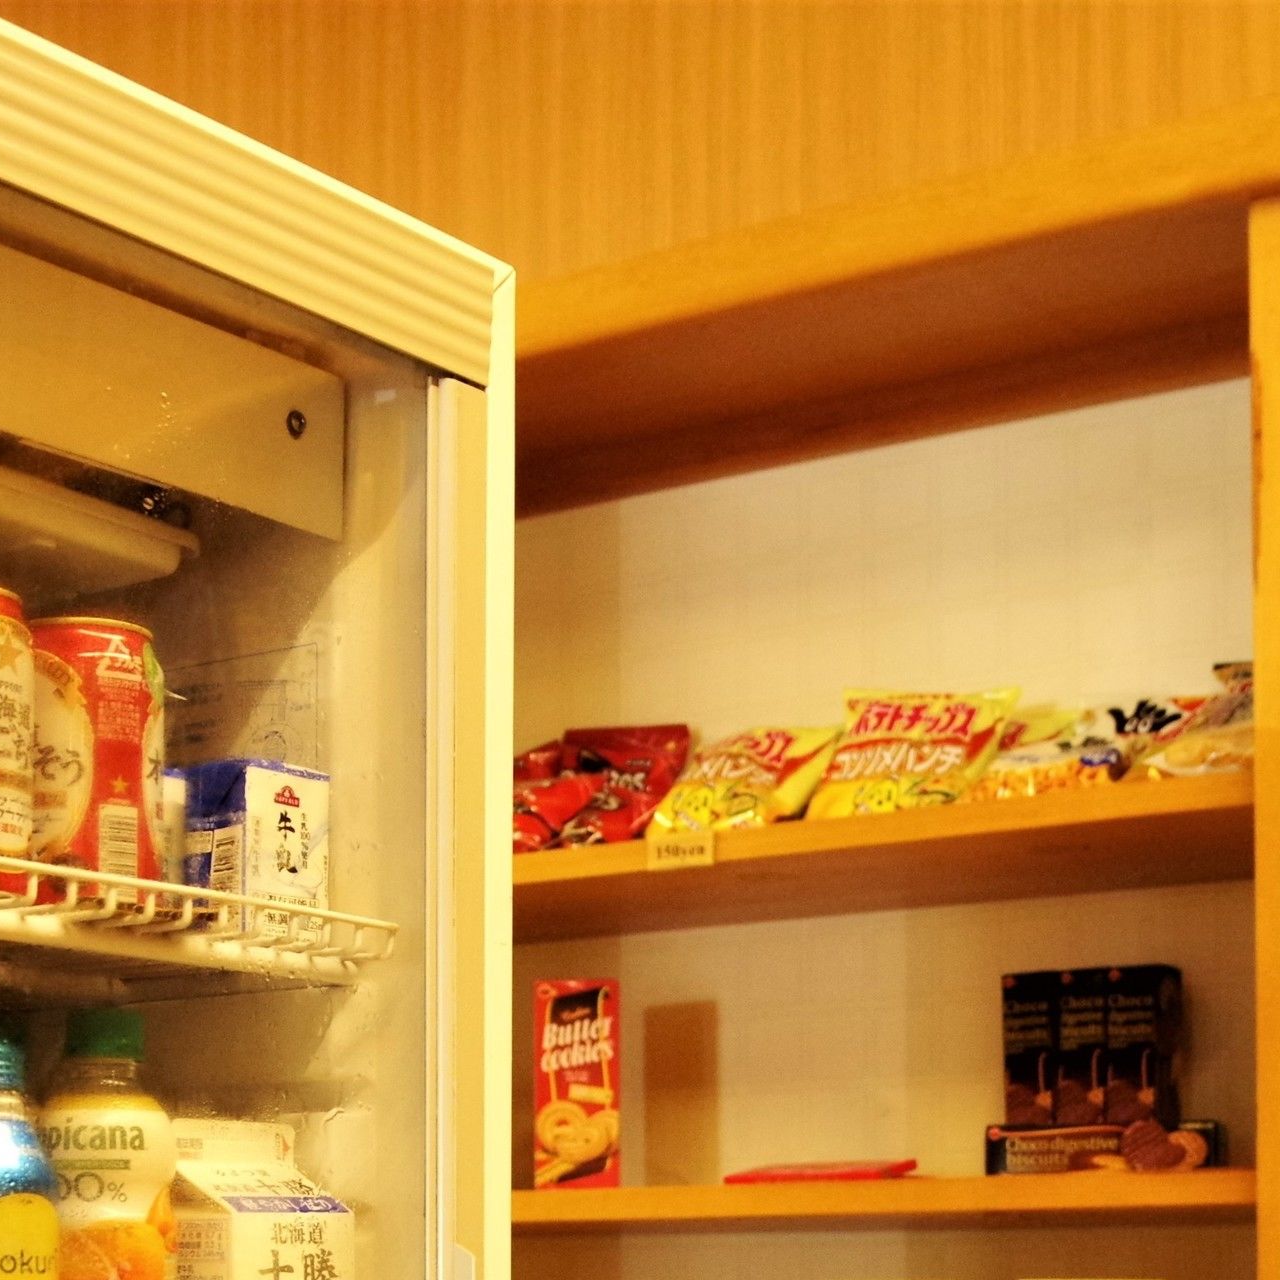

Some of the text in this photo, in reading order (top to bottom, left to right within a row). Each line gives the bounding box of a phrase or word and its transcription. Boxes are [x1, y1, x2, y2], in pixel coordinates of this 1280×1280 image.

[851, 703, 976, 738] ポテトチップス
[271, 1223, 325, 1247] 北海道
